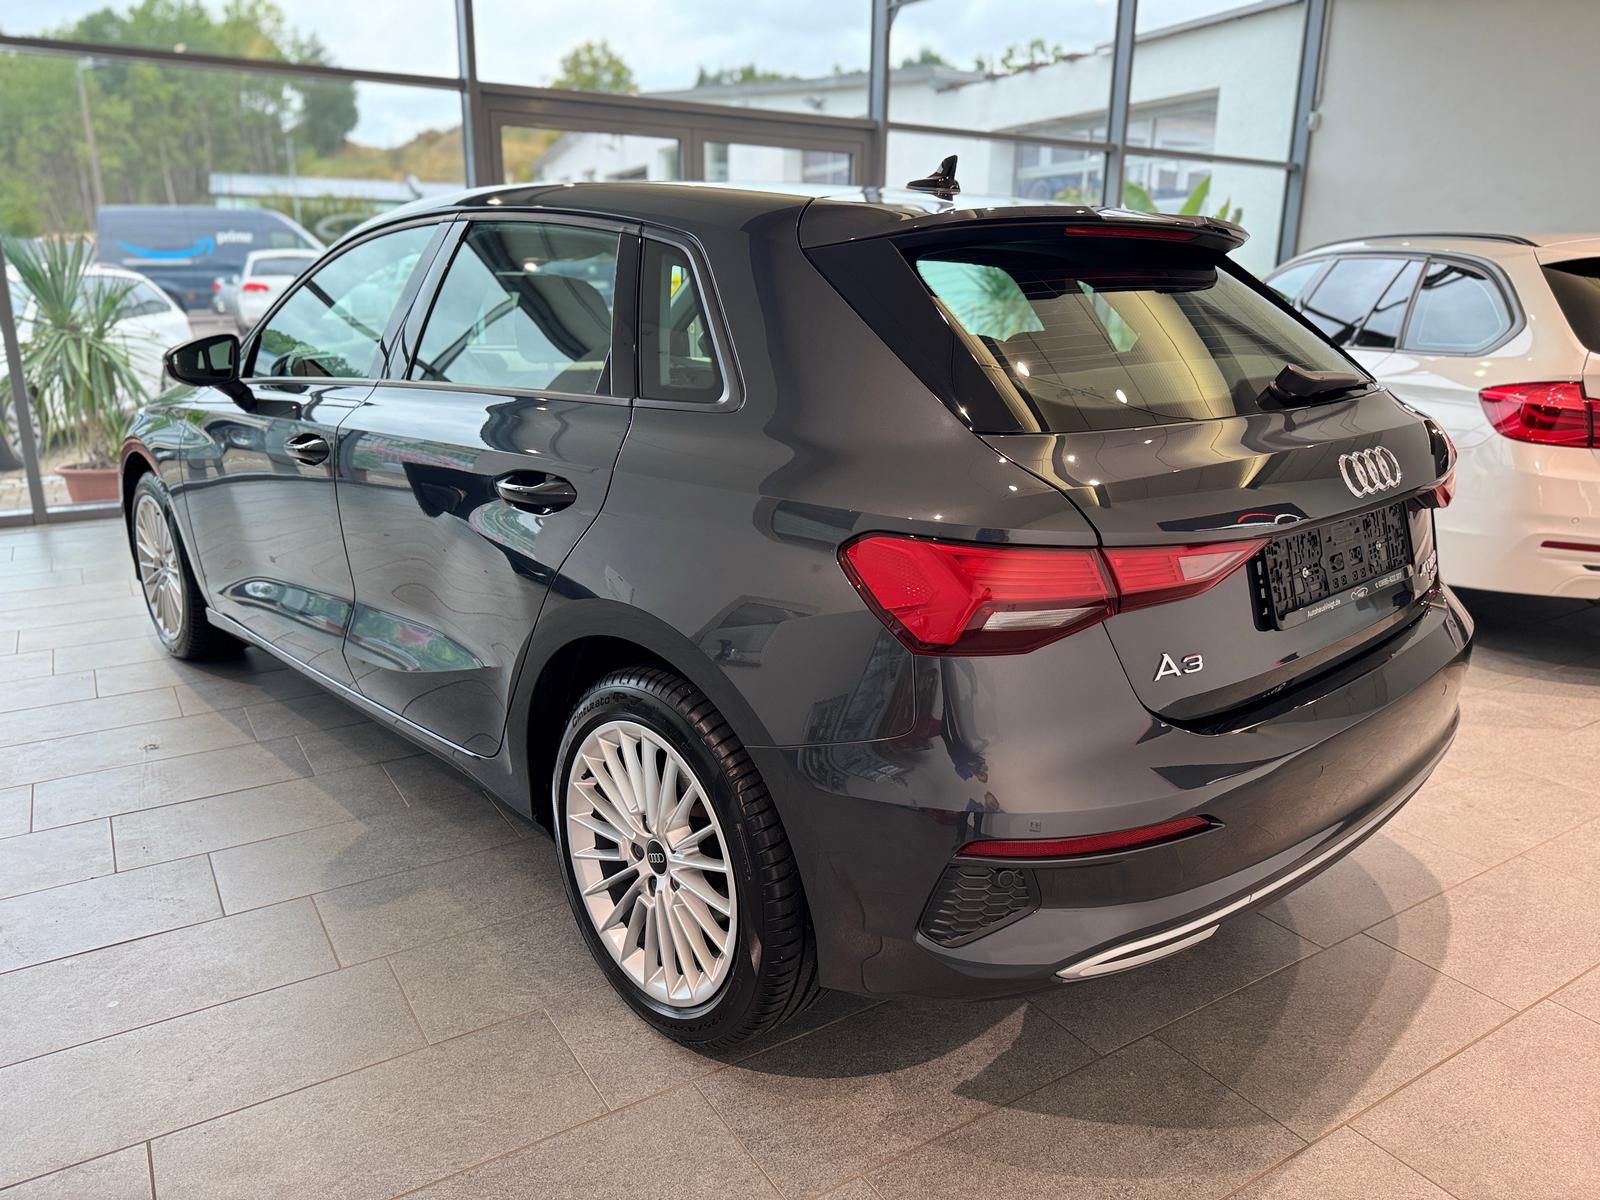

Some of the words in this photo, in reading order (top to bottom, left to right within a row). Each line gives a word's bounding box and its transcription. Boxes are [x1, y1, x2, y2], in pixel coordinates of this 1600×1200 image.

[216, 229, 253, 245] prime
[1152, 652, 1204, 682] A3
[572, 696, 611, 729] Cinturato
